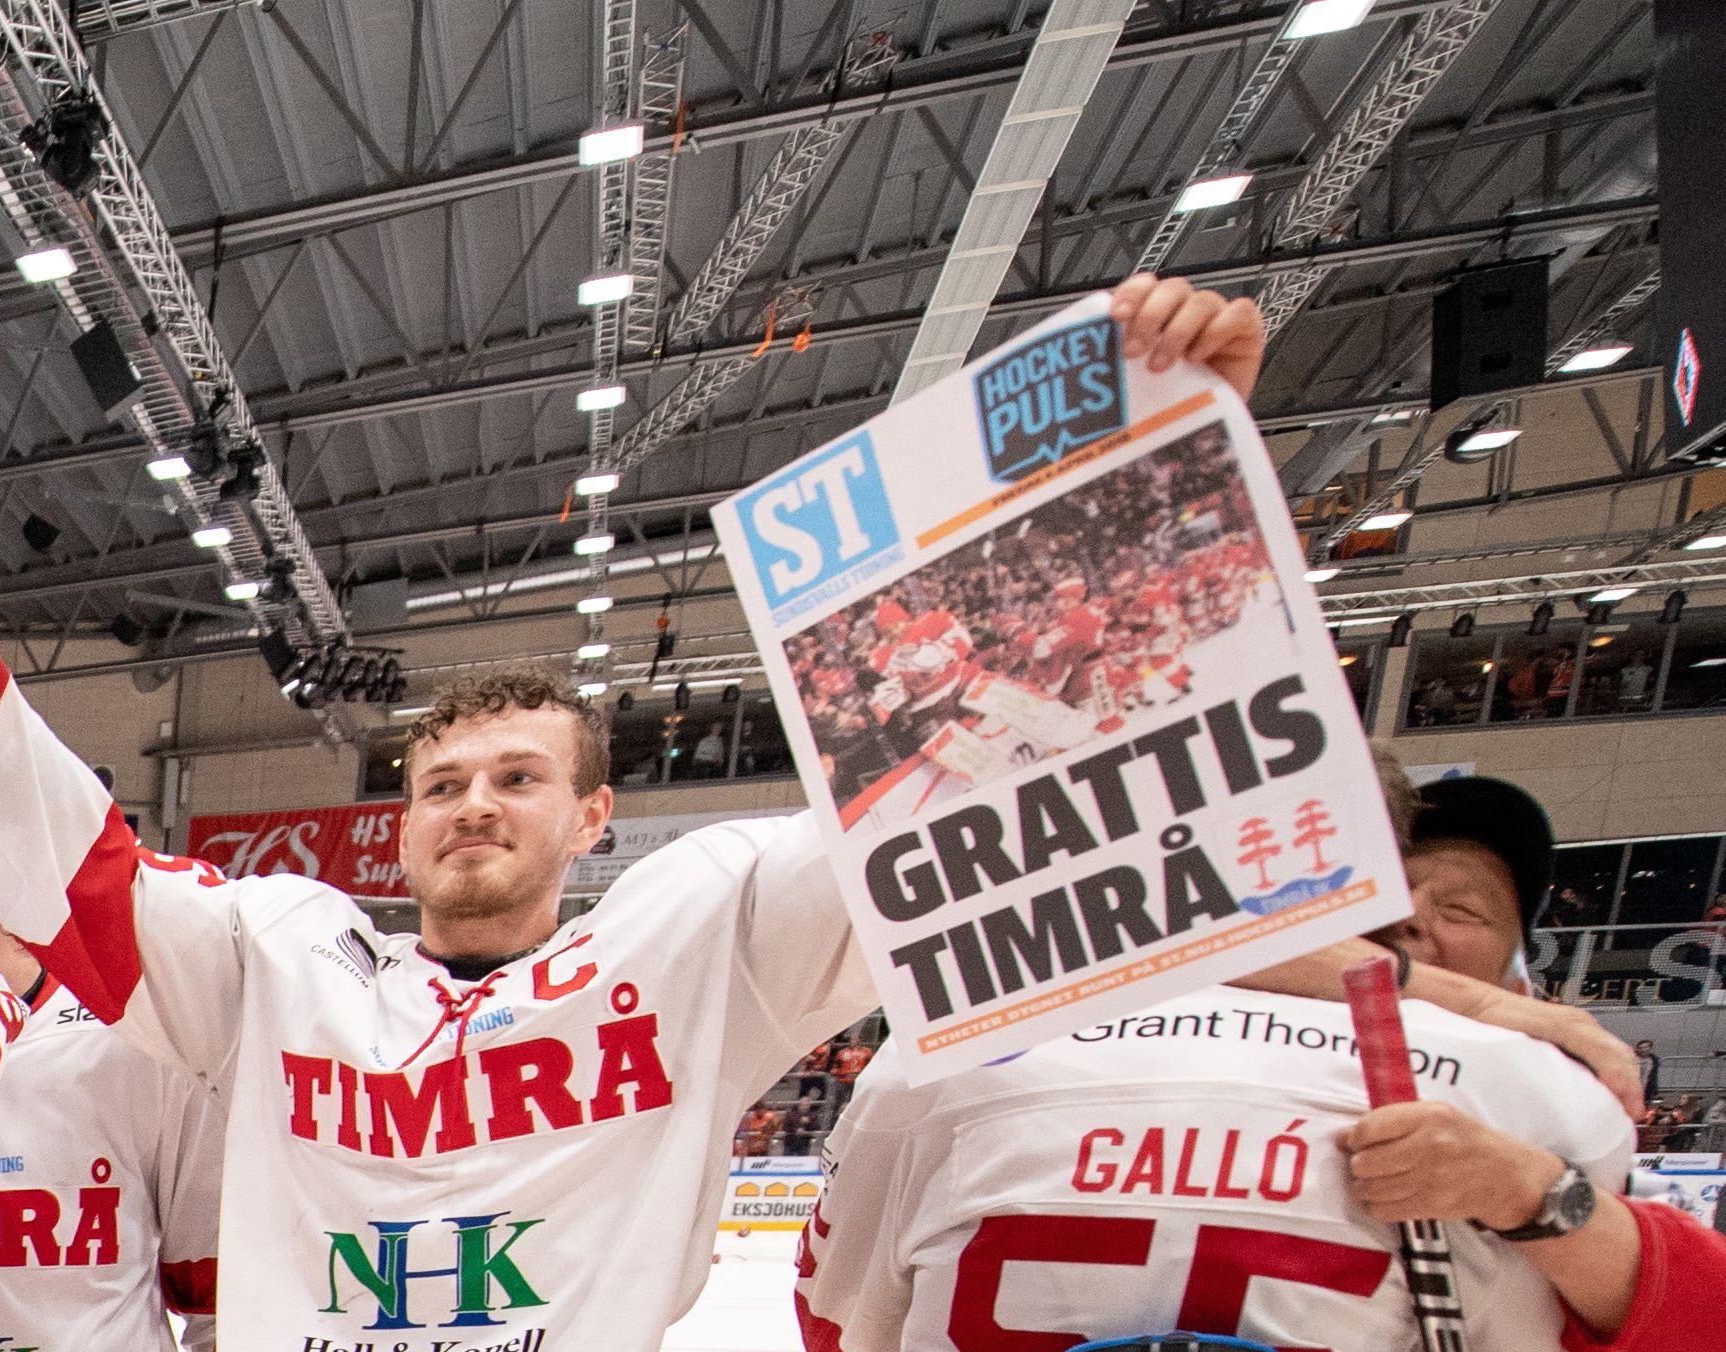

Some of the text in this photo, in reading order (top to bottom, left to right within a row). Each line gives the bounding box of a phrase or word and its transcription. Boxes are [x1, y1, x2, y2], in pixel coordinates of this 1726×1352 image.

[982, 324, 1115, 394] HOCKEY
[988, 365, 1125, 456] PULS
[753, 444, 868, 596] ST
[351, 812, 394, 848] HS
[863, 673, 1327, 924] GRATTIS
[310, 942, 370, 990] CASTELLUM
[533, 933, 598, 1001] C
[891, 823, 1241, 1024] TIMRÅ
[280, 981, 674, 1160] TIMRÅ
[1070, 1119, 1310, 1203] GALLÓ
